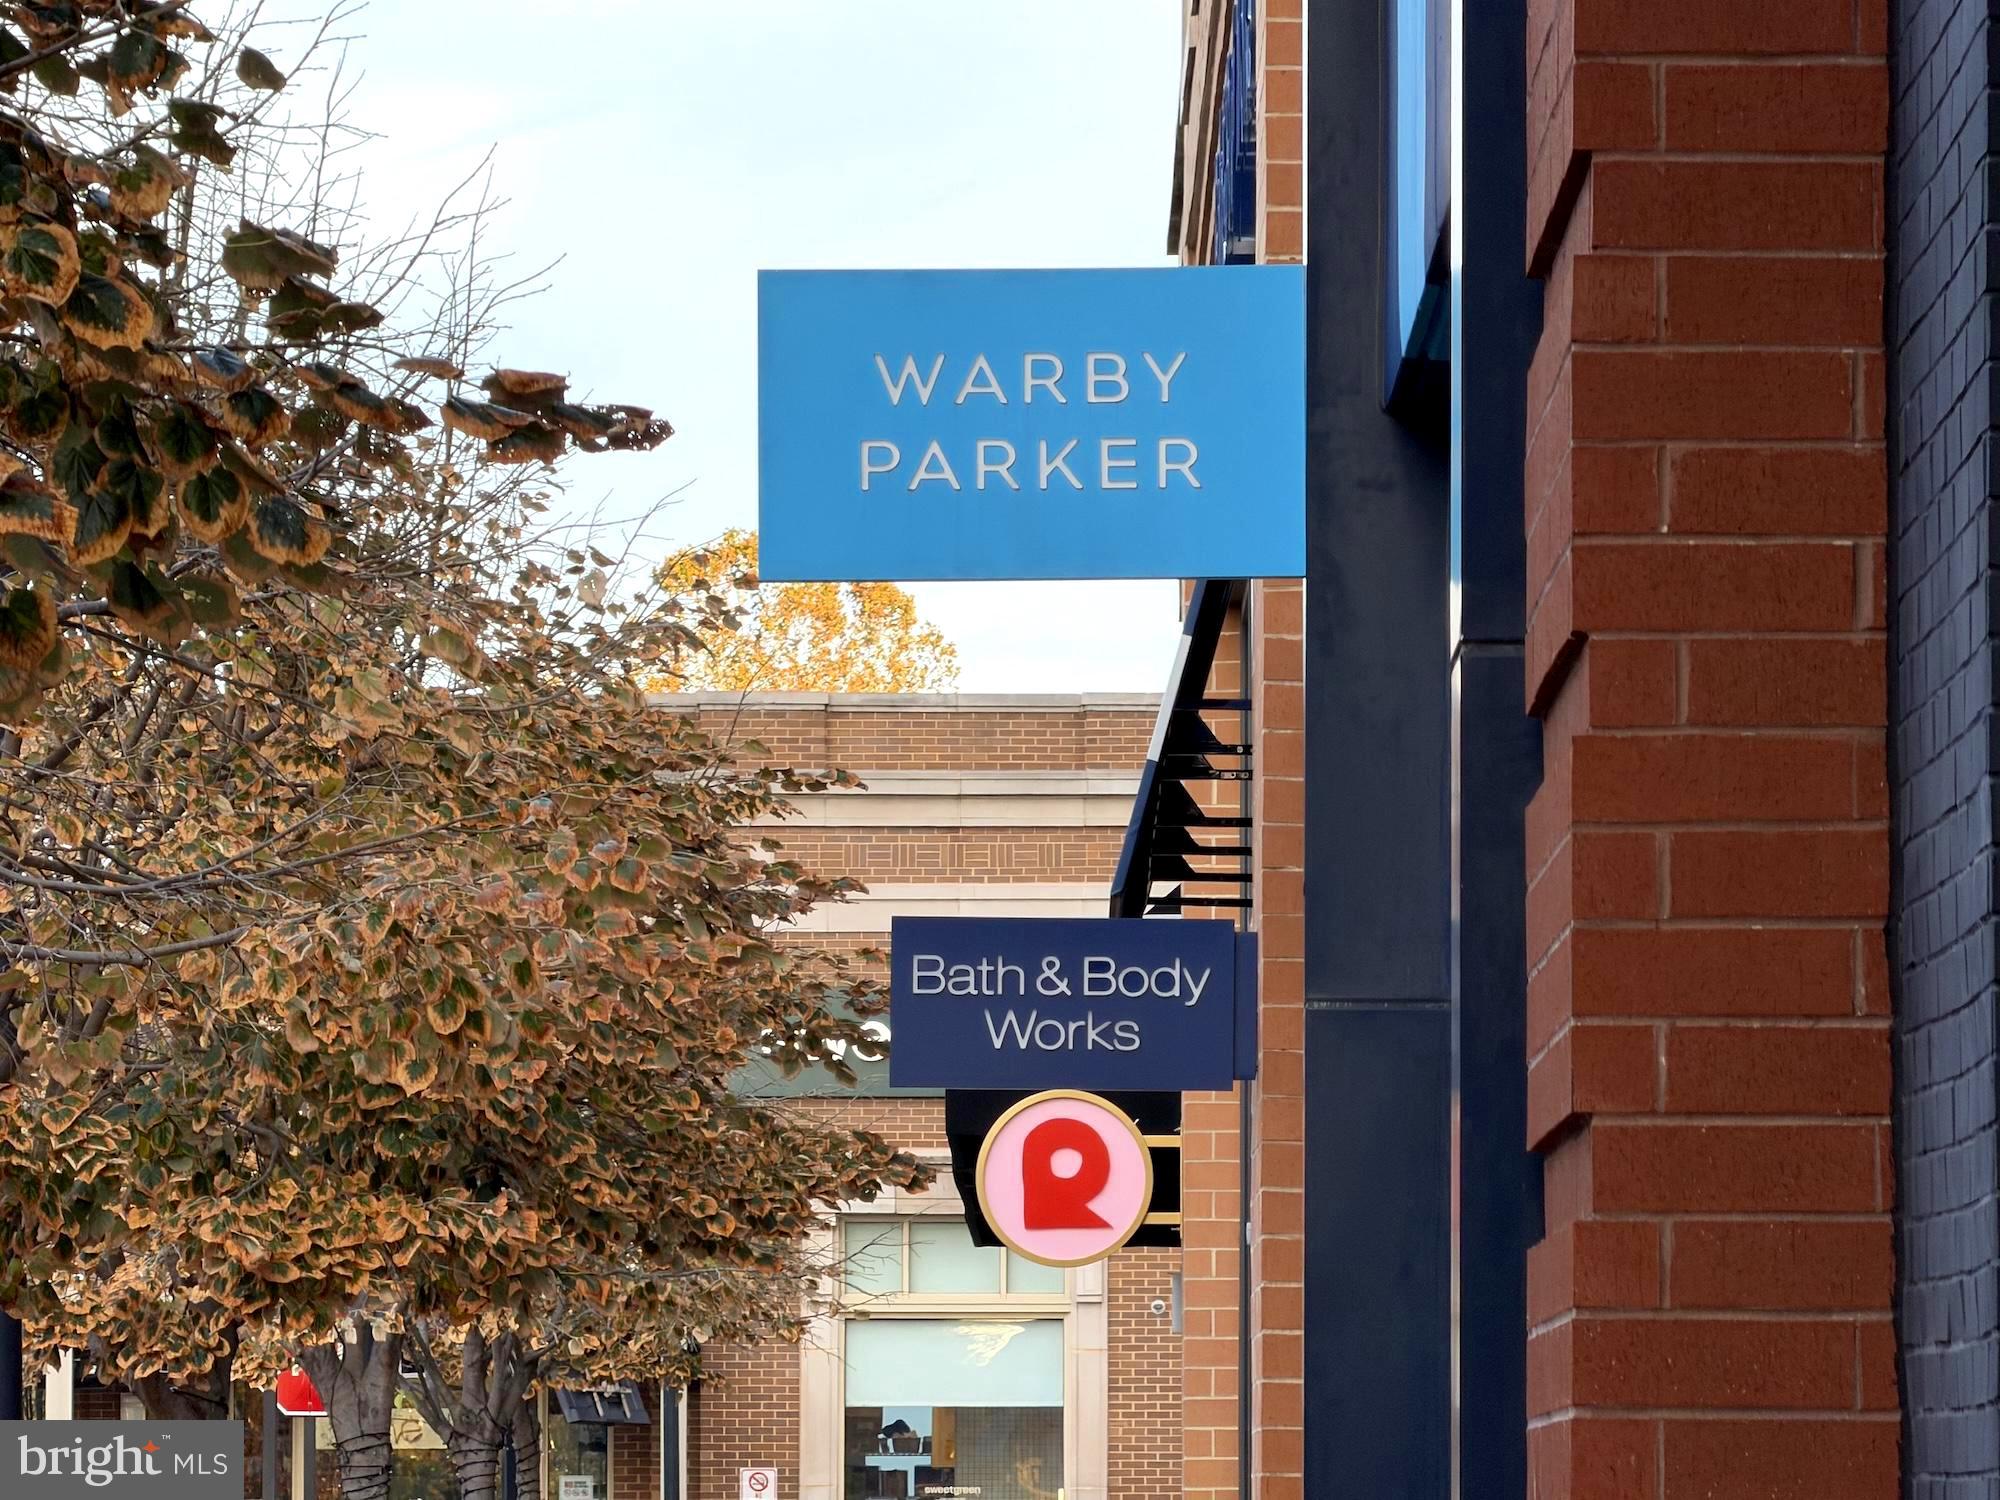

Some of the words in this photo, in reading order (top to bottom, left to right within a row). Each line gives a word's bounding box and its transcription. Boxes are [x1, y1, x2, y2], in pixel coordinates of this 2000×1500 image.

[875, 351, 1187, 406] WARBY
[860, 437, 1202, 491] PARKER
[911, 954, 1025, 996] Bath
[1035, 955, 1072, 997] &
[1083, 956, 1211, 1006] Body
[984, 1009, 1141, 1051] Works
